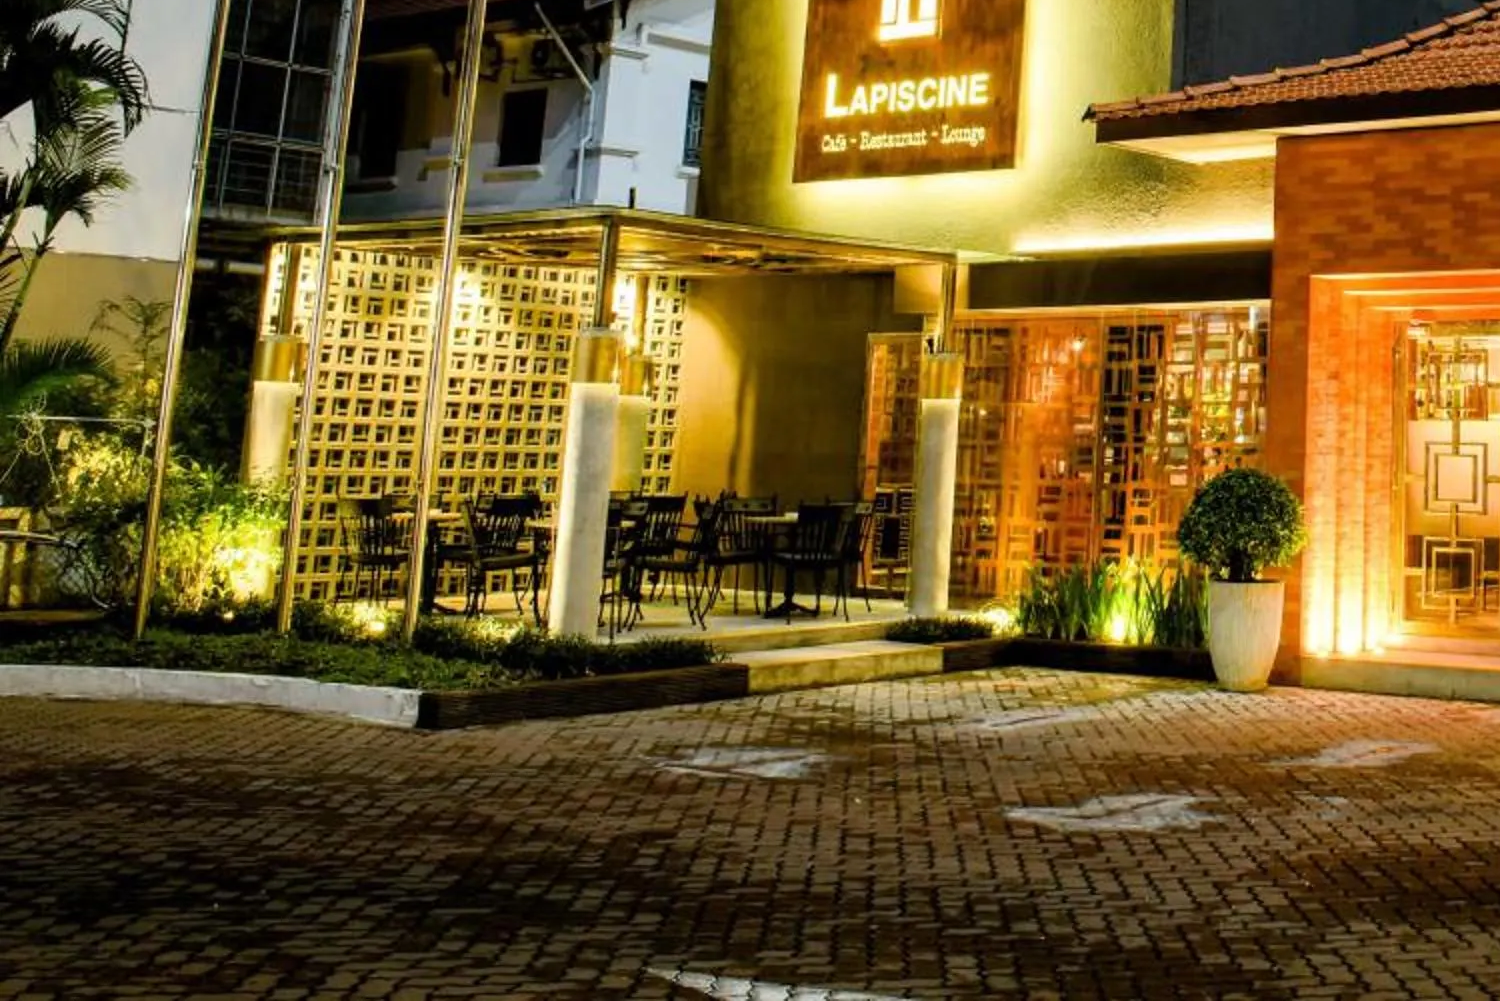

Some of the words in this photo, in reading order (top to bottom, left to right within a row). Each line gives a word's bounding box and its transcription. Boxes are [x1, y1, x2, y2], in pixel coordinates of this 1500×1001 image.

[824, 72, 990, 118] LAPISCINE
[859, 129, 928, 151] Restaurant
[940, 124, 986, 147] Lounge
